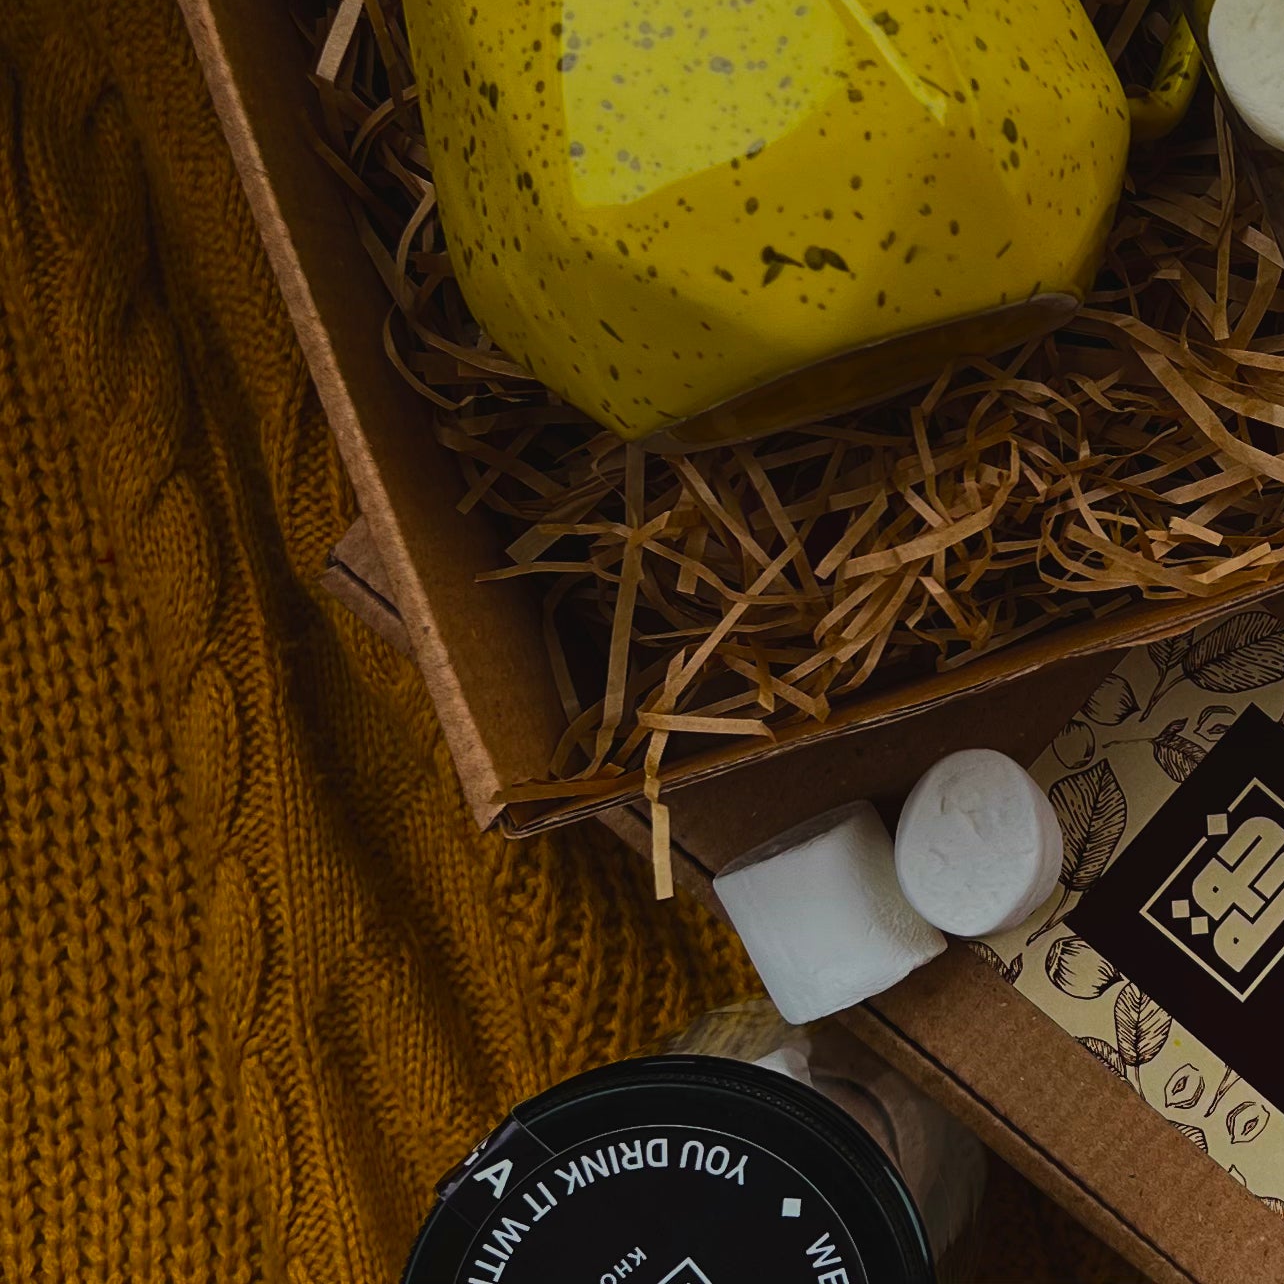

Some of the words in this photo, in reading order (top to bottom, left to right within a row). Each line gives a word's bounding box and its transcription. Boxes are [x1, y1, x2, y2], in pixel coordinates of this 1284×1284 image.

[553, 1138, 669, 1196] DRINK
[679, 1140, 749, 1186] YOU
[522, 1181, 558, 1222] IT
